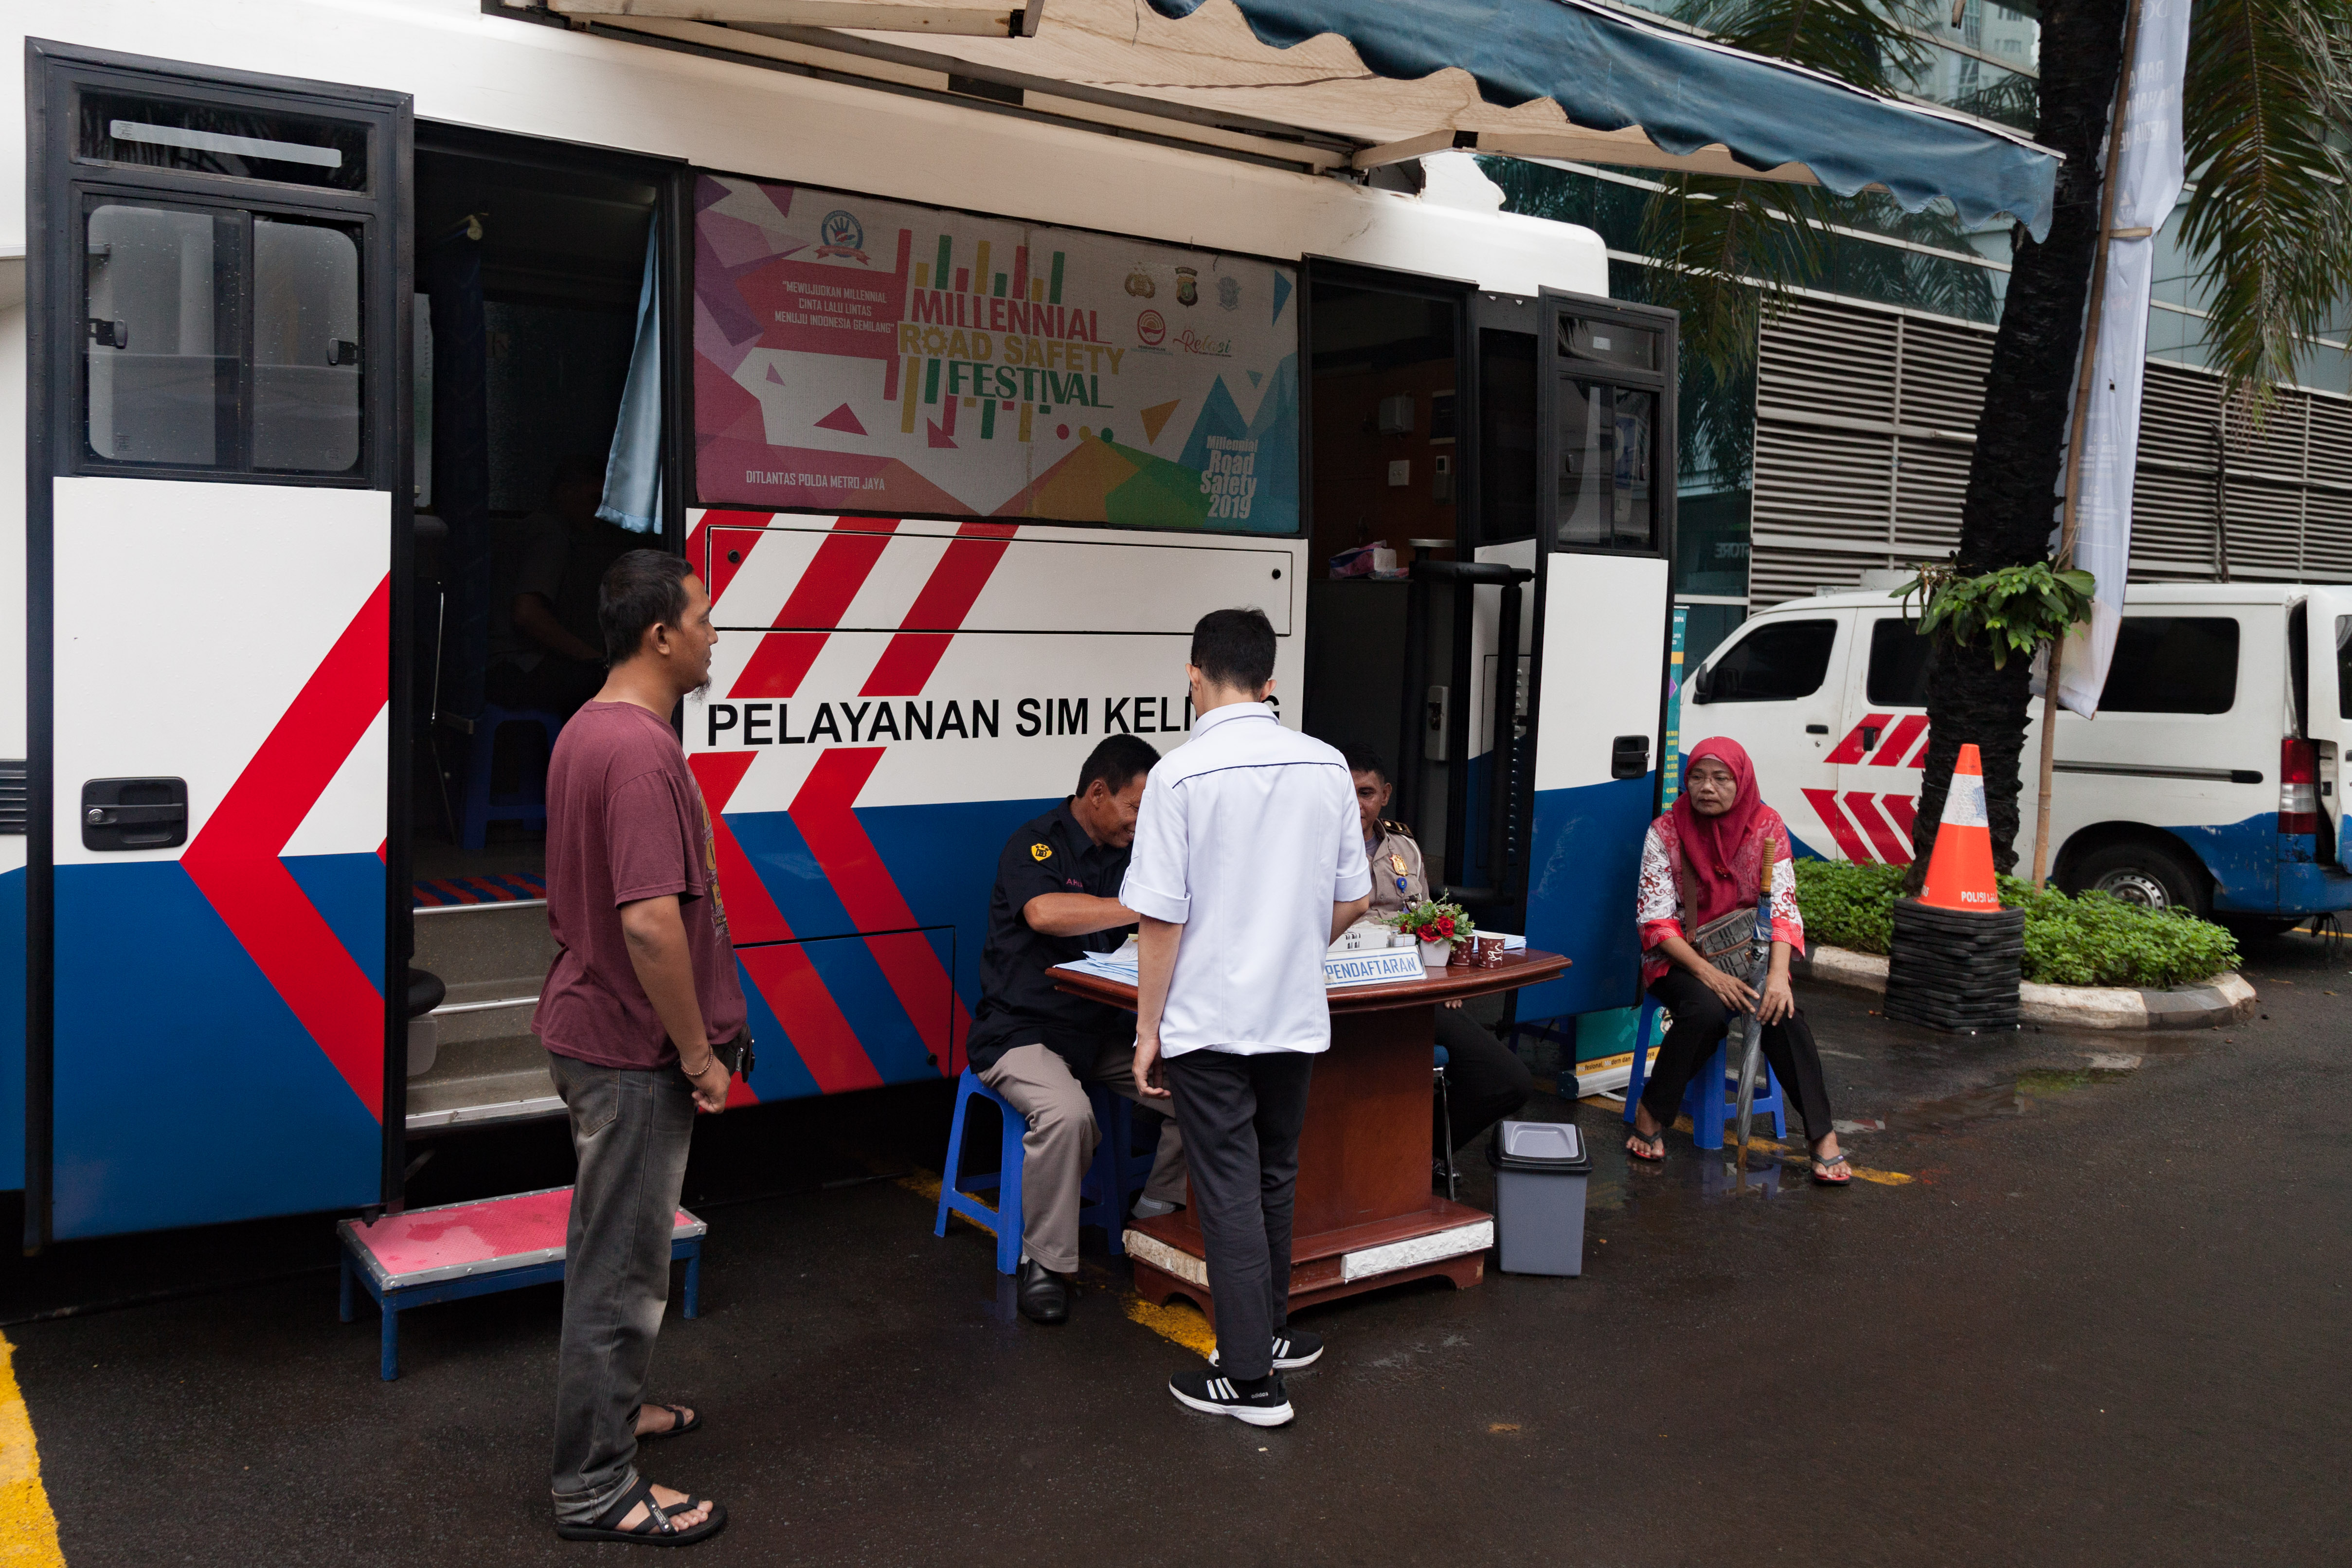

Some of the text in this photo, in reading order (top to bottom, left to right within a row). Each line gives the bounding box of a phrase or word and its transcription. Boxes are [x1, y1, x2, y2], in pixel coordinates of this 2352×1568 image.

[782, 280, 887, 304] "MEWUJUDKAN MILLENNIAL
[799, 298, 872, 317] CINTA LALU LINTAS
[912, 288, 1113, 344] MILLENNIAL
[775, 310, 895, 334] MENUJU INDONESIA GEMILANG"
[899, 323, 1125, 375] ROAD SAFETY
[948, 360, 1114, 409] FESTIVAL
[1206, 435, 1258, 452] Millennial
[1209, 450, 1255, 475] Road
[746, 470, 885, 491] DITLANTAS POLDA METRO JAYA
[1200, 470, 1257, 499] Safety
[1207, 494, 1252, 519] 2019
[708, 694, 1280, 746] PELAYANAN SIM KELIG
[1961, 891, 1986, 903] POLISI
[1326, 956, 1417, 980] PENDAFTARAN
[1577, 1062, 1604, 1073] Profesional,
[1604, 1058, 1621, 1066] Modern
